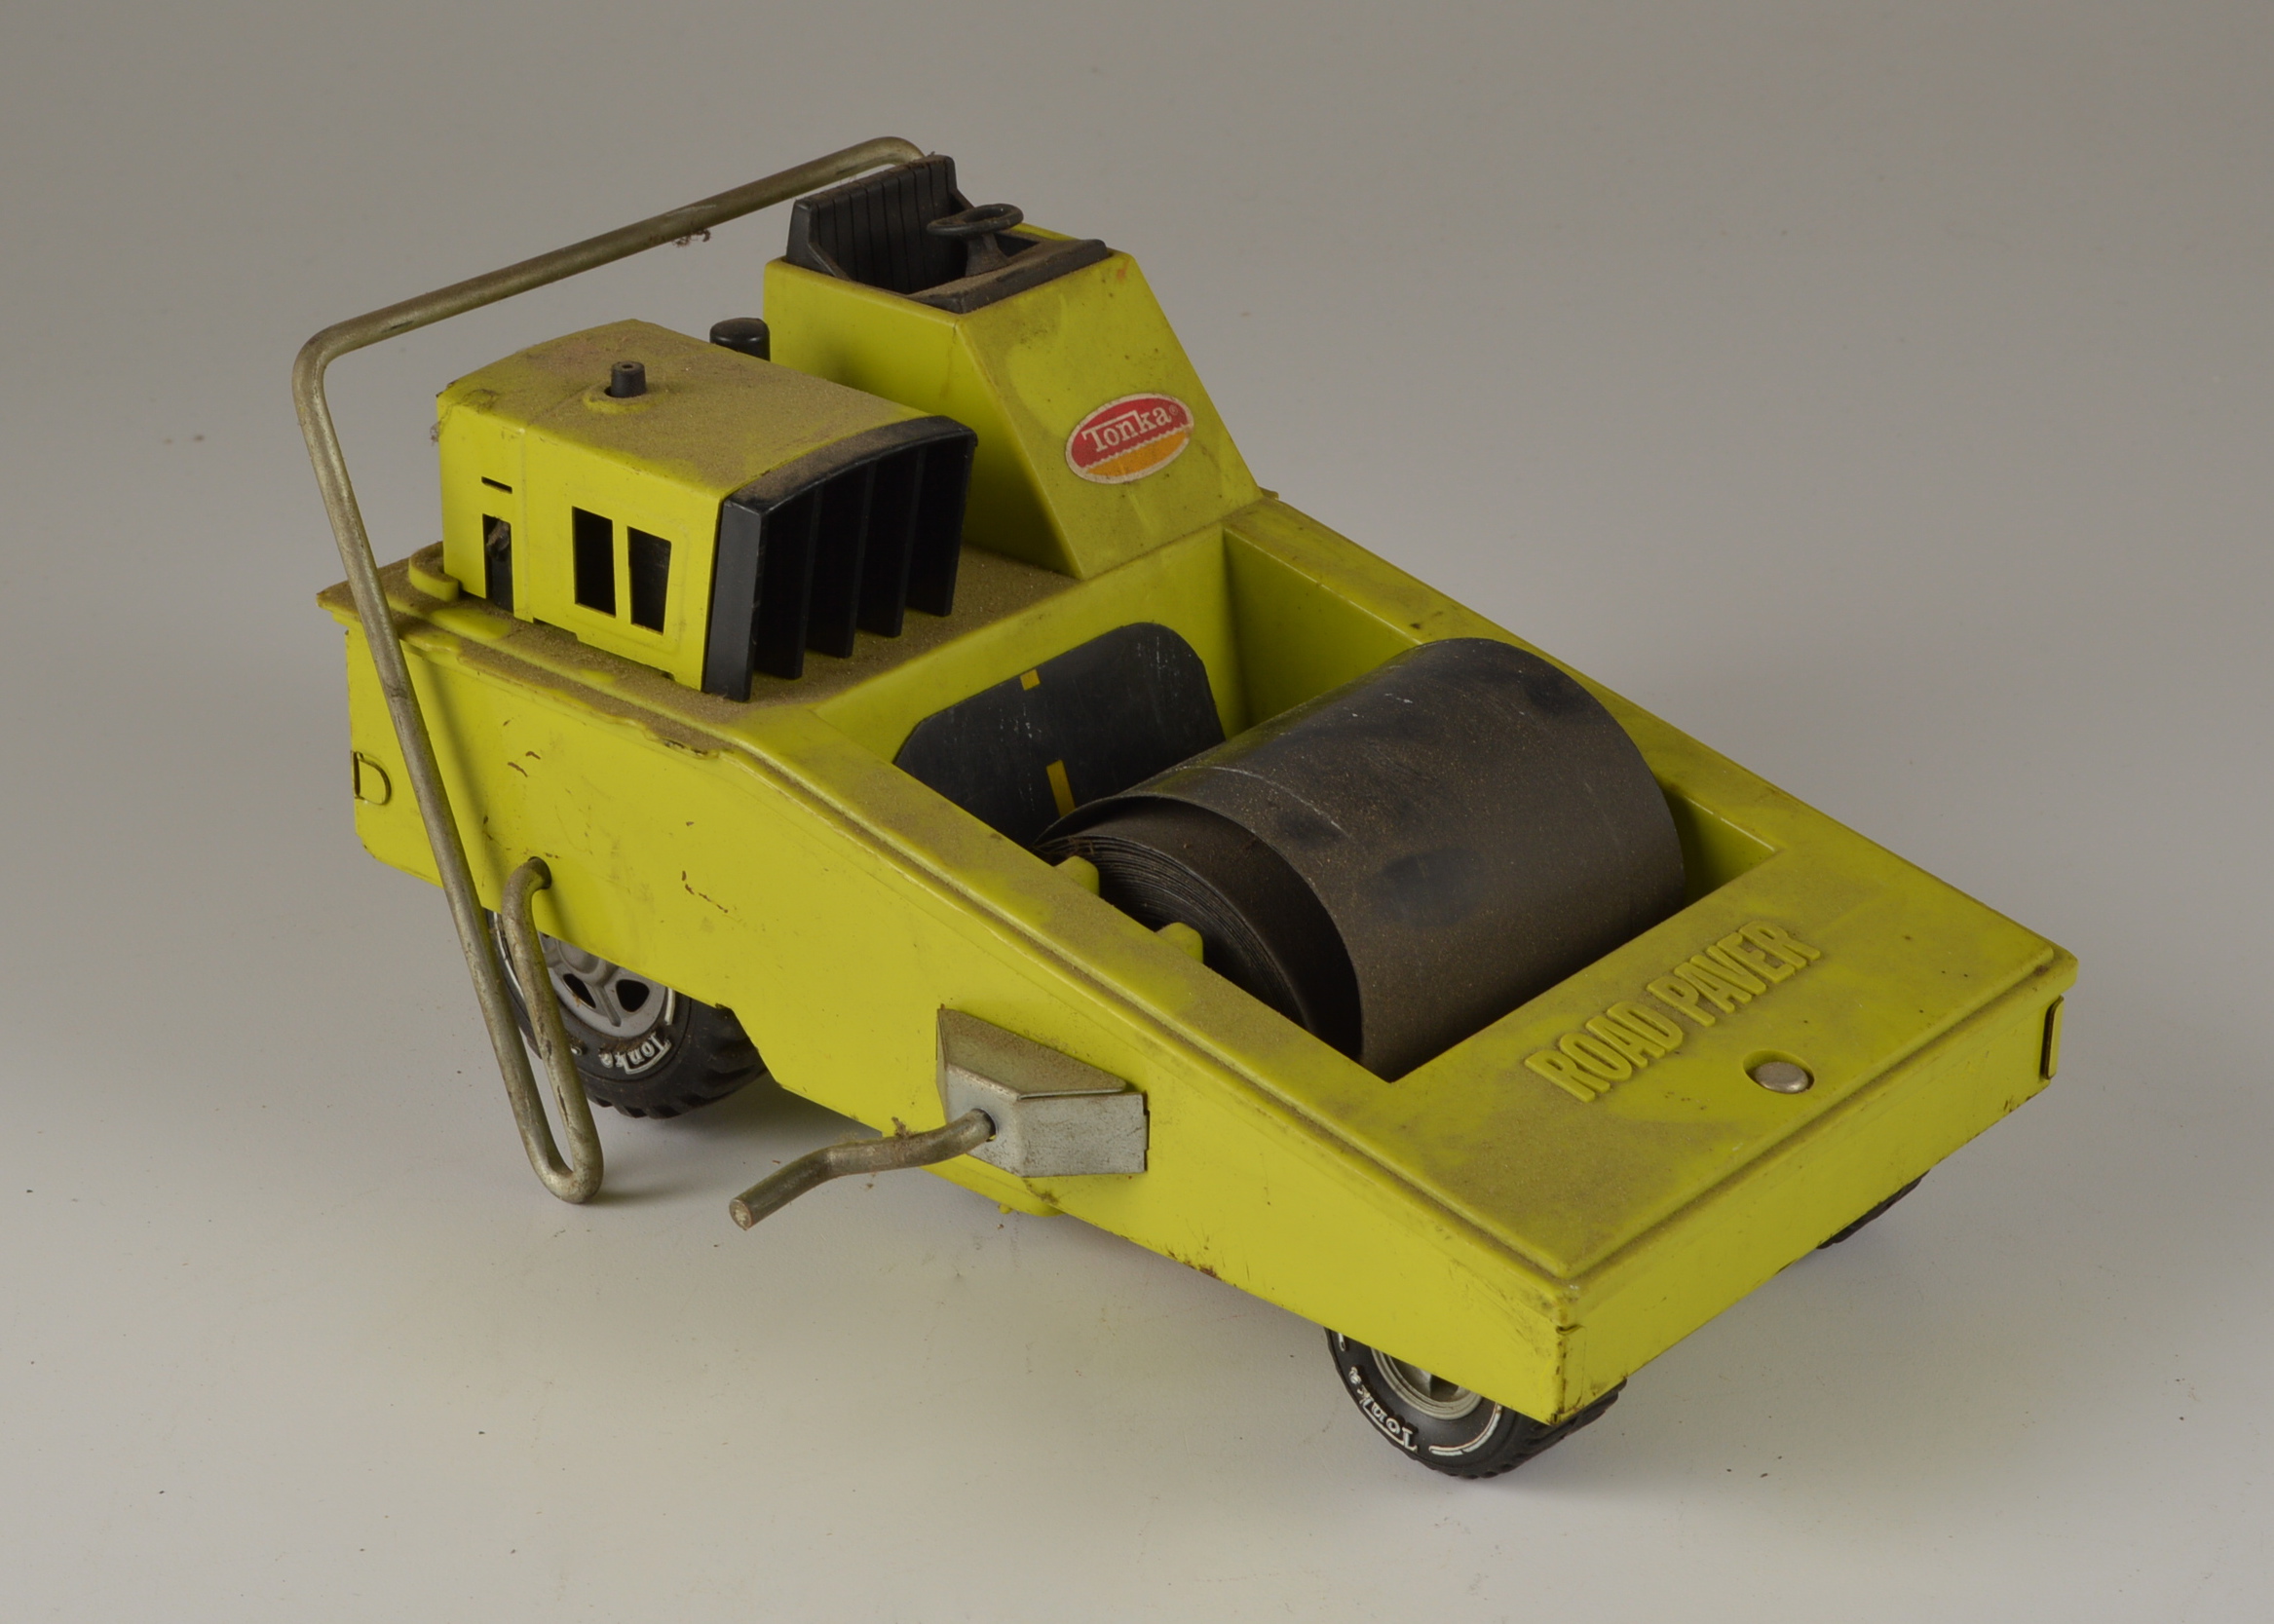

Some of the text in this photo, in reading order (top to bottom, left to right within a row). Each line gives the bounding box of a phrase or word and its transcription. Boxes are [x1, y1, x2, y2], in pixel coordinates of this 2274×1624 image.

[598, 1033, 672, 1075] Tonka
[1525, 922, 1821, 1103] ROAD PAVER
[1348, 1366, 1419, 1453] Tonka
